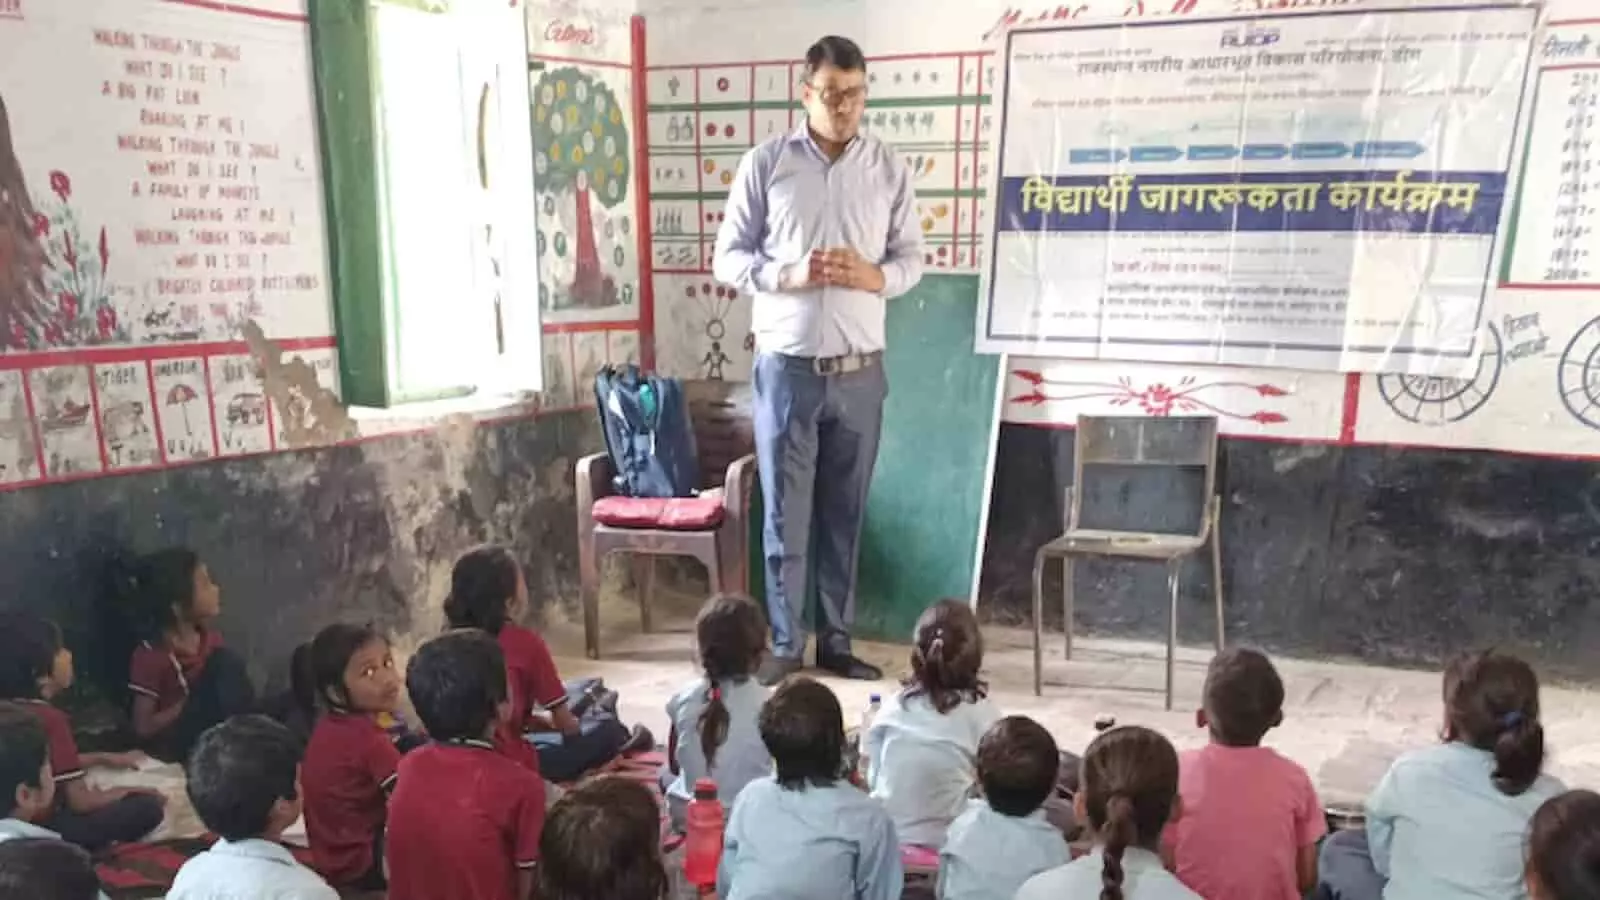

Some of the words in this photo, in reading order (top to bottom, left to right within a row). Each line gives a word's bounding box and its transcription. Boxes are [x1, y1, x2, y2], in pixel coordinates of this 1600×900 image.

[101, 79, 112, 96] A
[117, 81, 136, 99] BIG
[1021, 171, 1134, 215] विद्यार्थी
[1138, 182, 1323, 213] जागरूकता
[1328, 168, 1480, 214] कार्यक्रम
